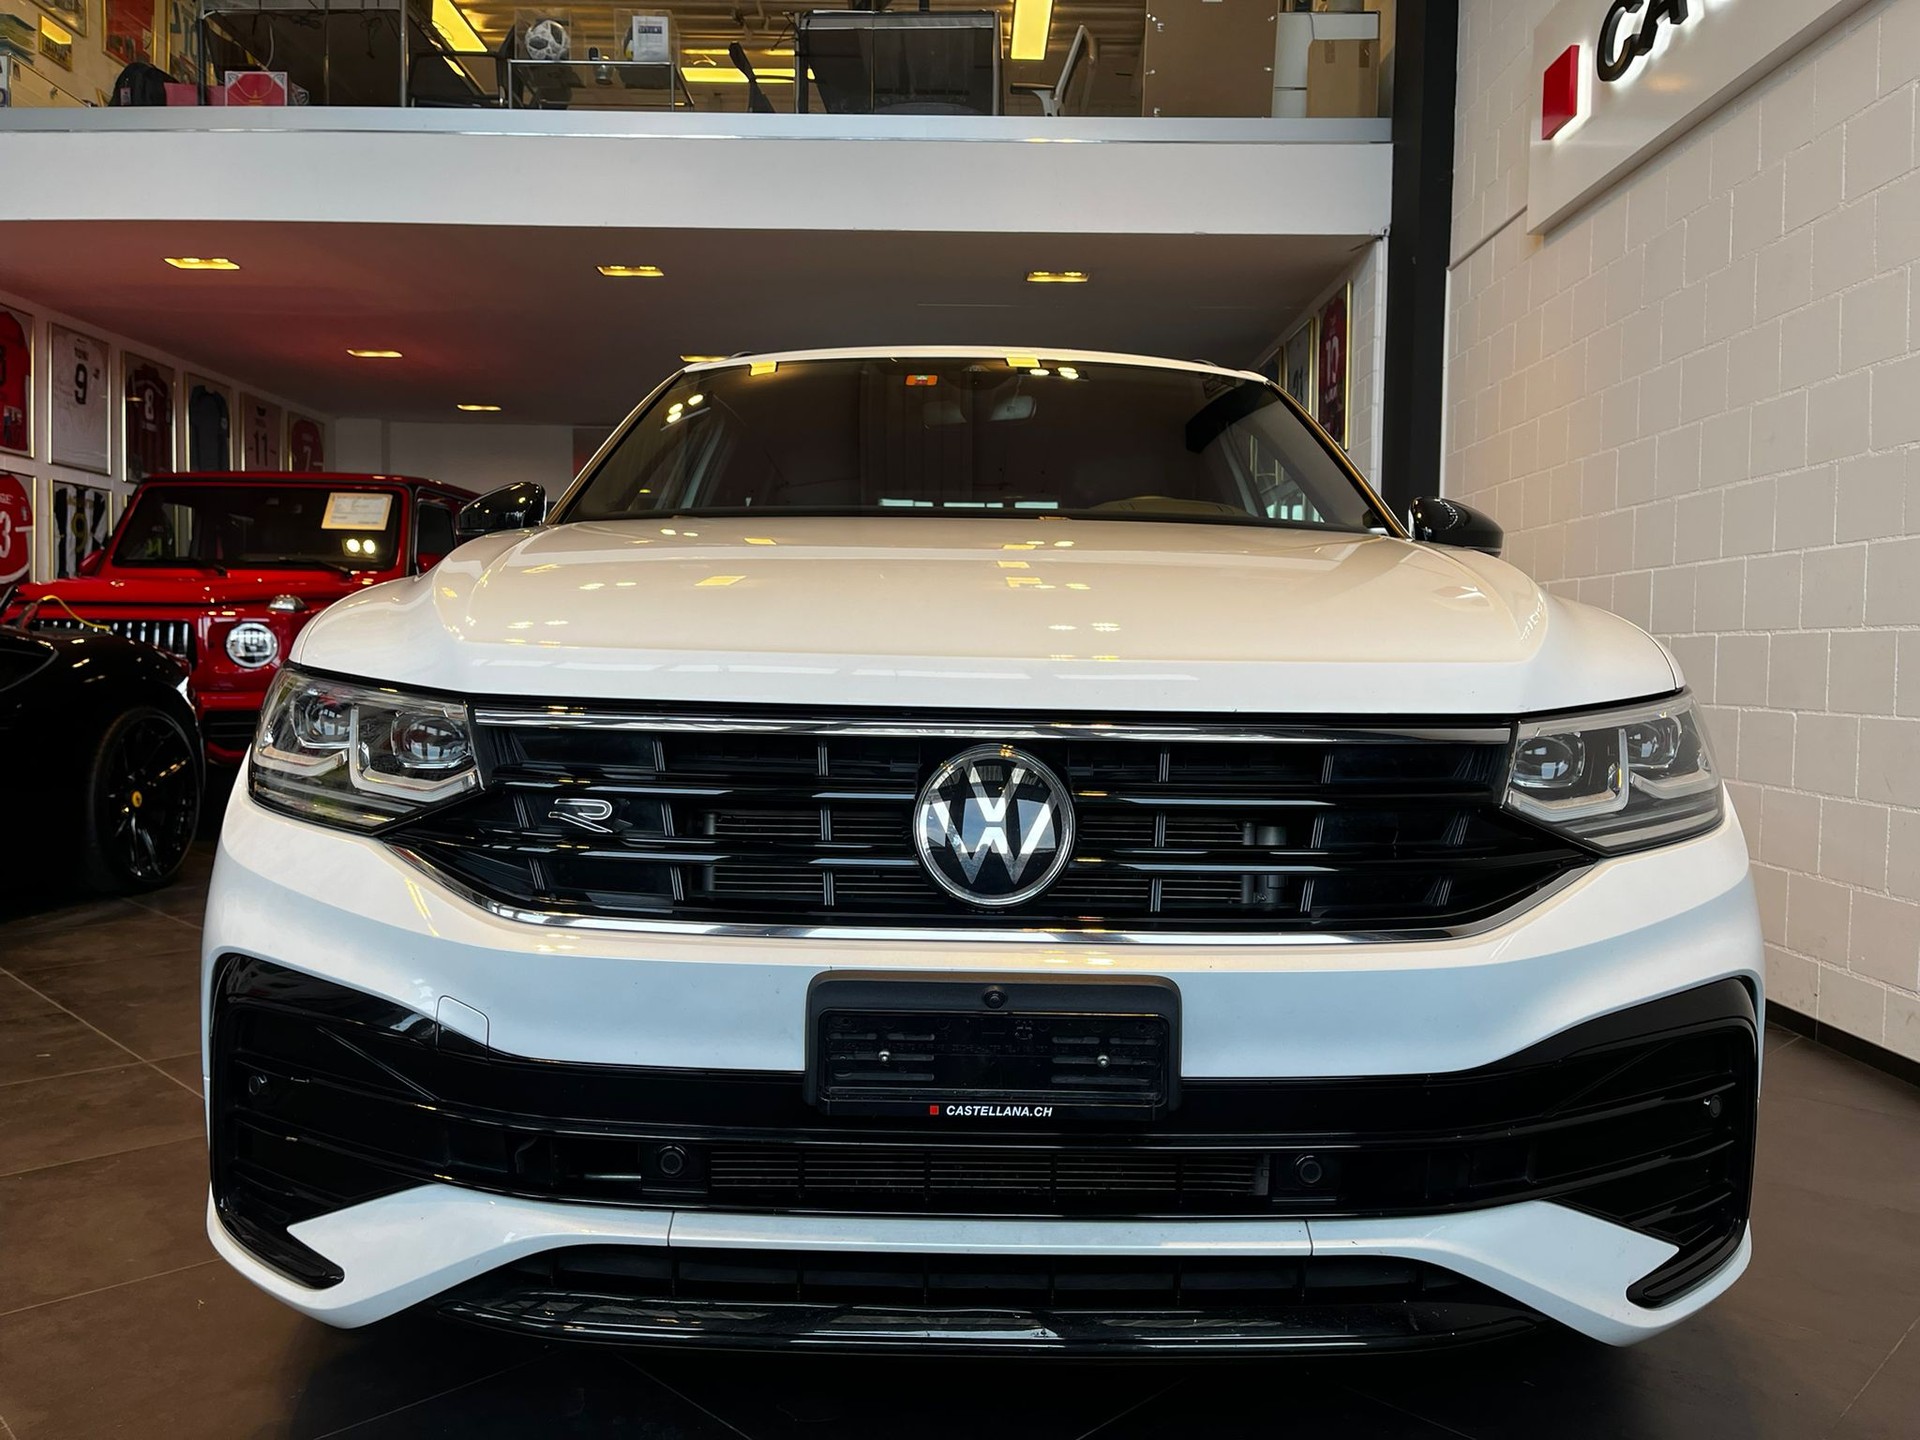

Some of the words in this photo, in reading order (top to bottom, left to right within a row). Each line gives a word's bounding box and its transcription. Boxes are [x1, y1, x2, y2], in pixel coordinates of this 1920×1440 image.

[74, 363, 87, 404] 9
[144, 387, 155, 421] 8
[548, 798, 613, 833] R
[946, 1104, 1053, 1119] CASTELLANA.CH
